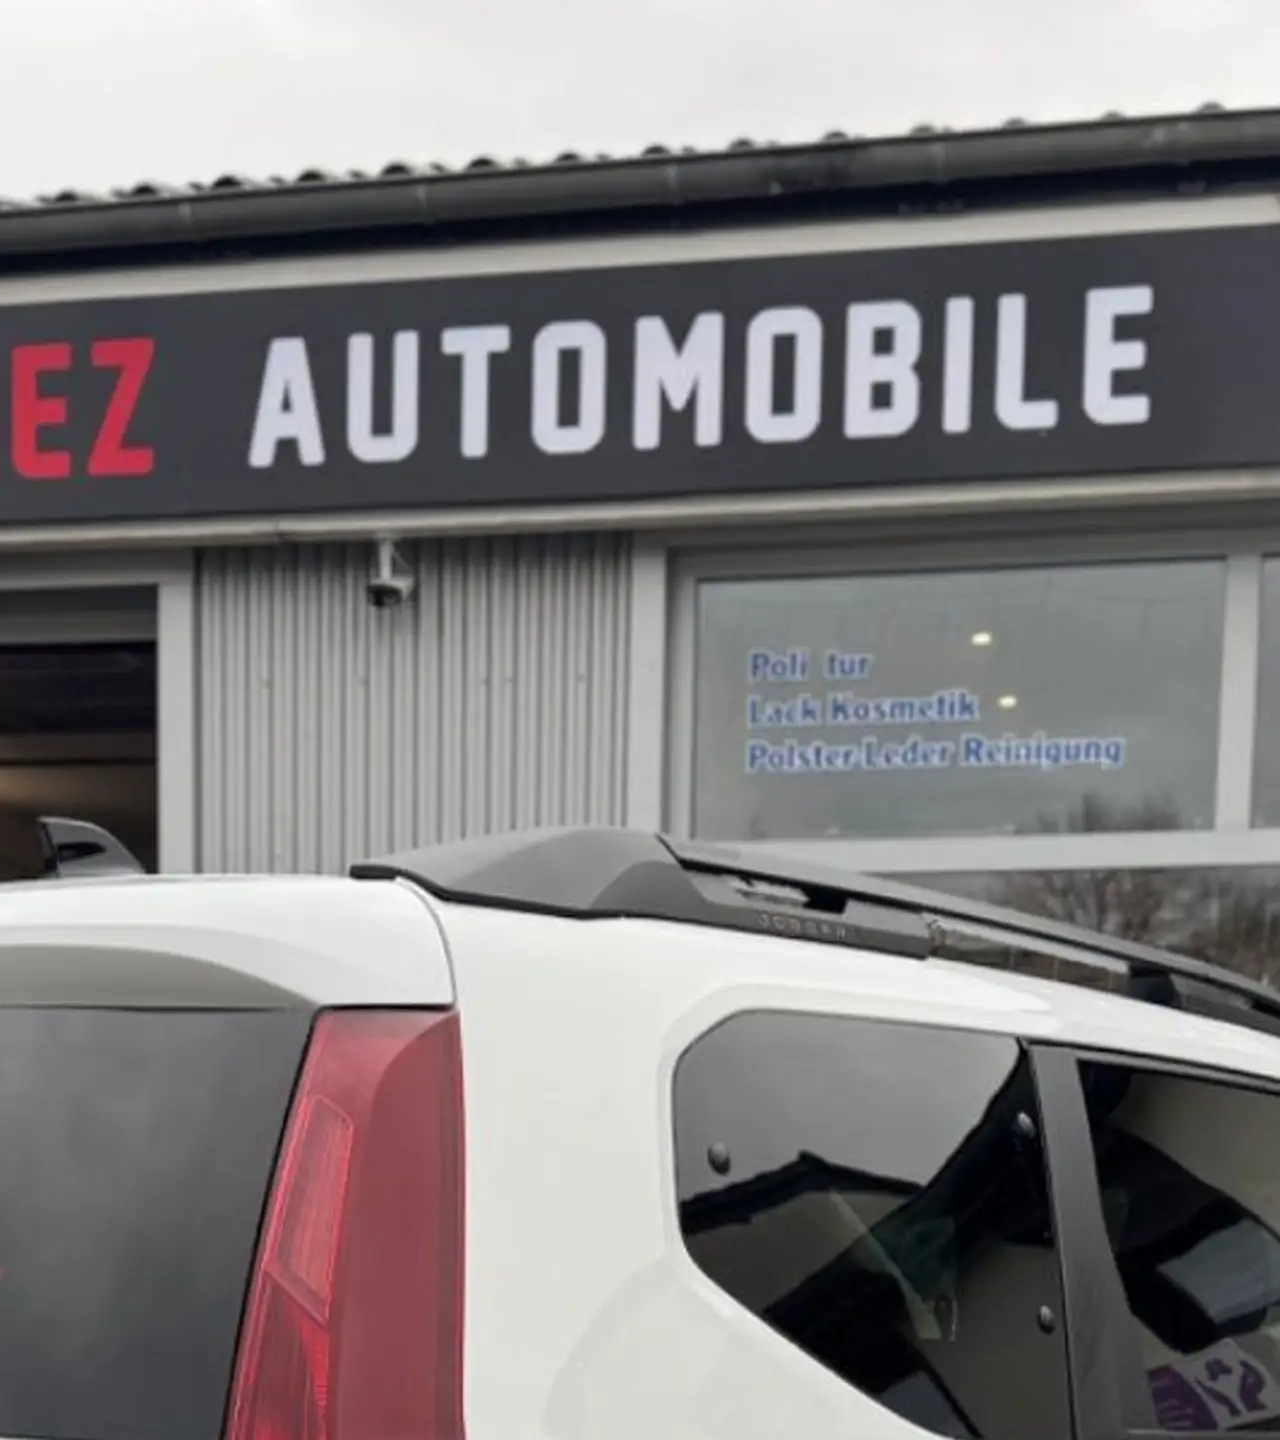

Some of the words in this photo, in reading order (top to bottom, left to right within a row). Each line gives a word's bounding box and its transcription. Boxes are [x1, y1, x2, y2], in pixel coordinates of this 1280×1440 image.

[247, 285, 1155, 471] AUTOMOBILE
[750, 650, 809, 681] Poli
[748, 700, 818, 727] Lack
[829, 692, 979, 725] Kosmetik
[962, 734, 1125, 768] Reinigung
